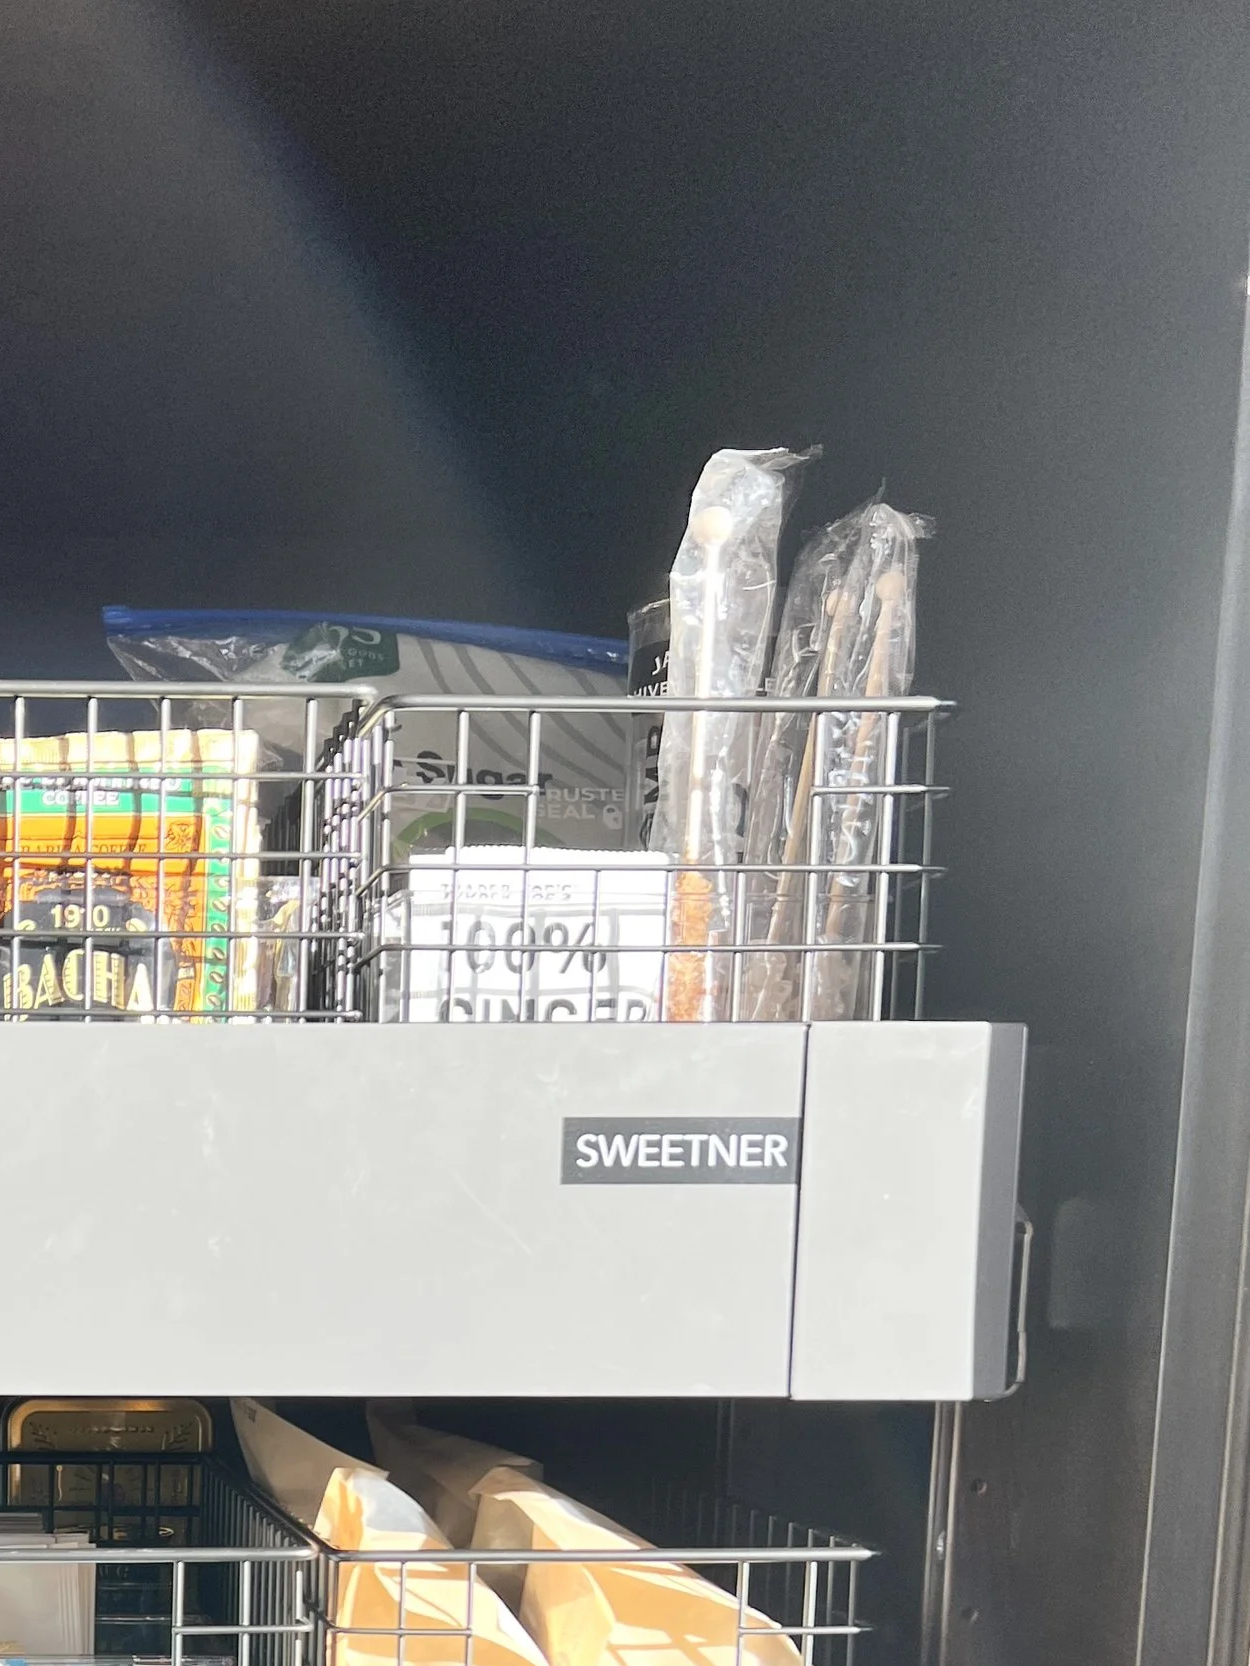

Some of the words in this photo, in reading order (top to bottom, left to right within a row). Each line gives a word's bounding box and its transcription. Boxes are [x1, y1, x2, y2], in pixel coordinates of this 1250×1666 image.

[540, 787, 624, 802] RUSTE
[50, 904, 110, 929] 190
[2, 948, 155, 1014] BACHA
[575, 1132, 790, 1168] SWEETNER
